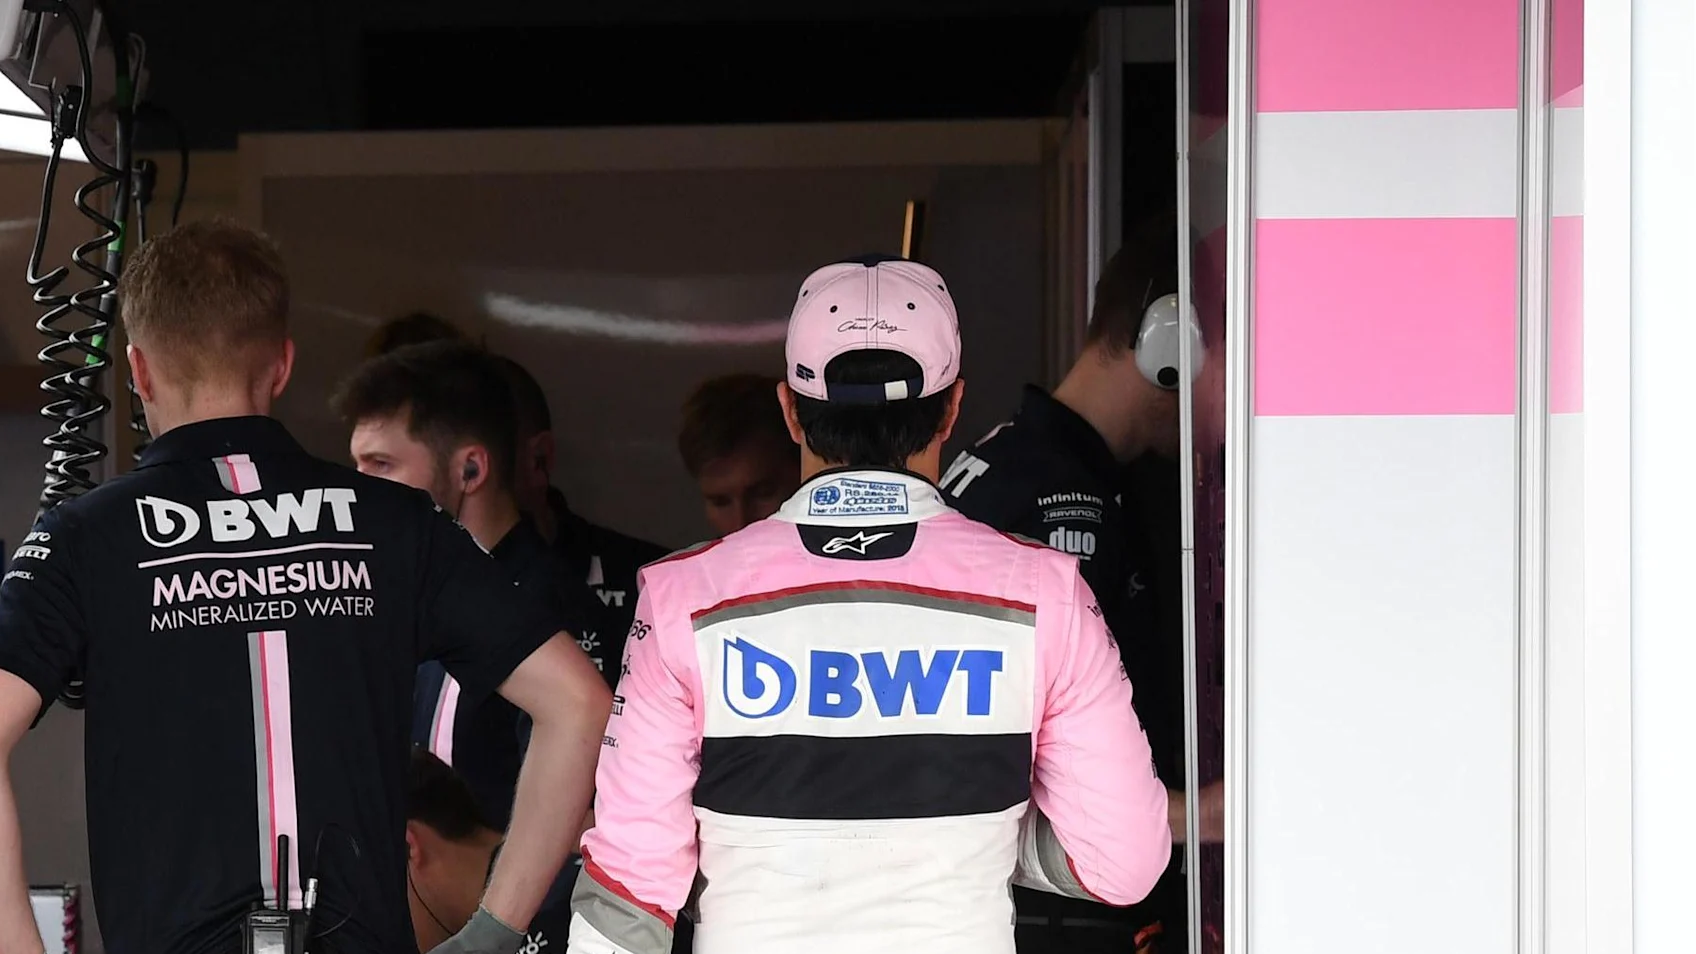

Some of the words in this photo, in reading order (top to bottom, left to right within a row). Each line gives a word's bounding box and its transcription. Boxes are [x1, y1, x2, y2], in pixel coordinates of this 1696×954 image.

[207, 488, 357, 542] BWT
[1037, 491, 1103, 507] infinitum
[1049, 526, 1096, 556] duo
[152, 560, 372, 607] MAGNESIUM
[150, 600, 297, 632] MINERALIZED
[304, 596, 375, 619] WATER
[808, 649, 1003, 718] BWT
